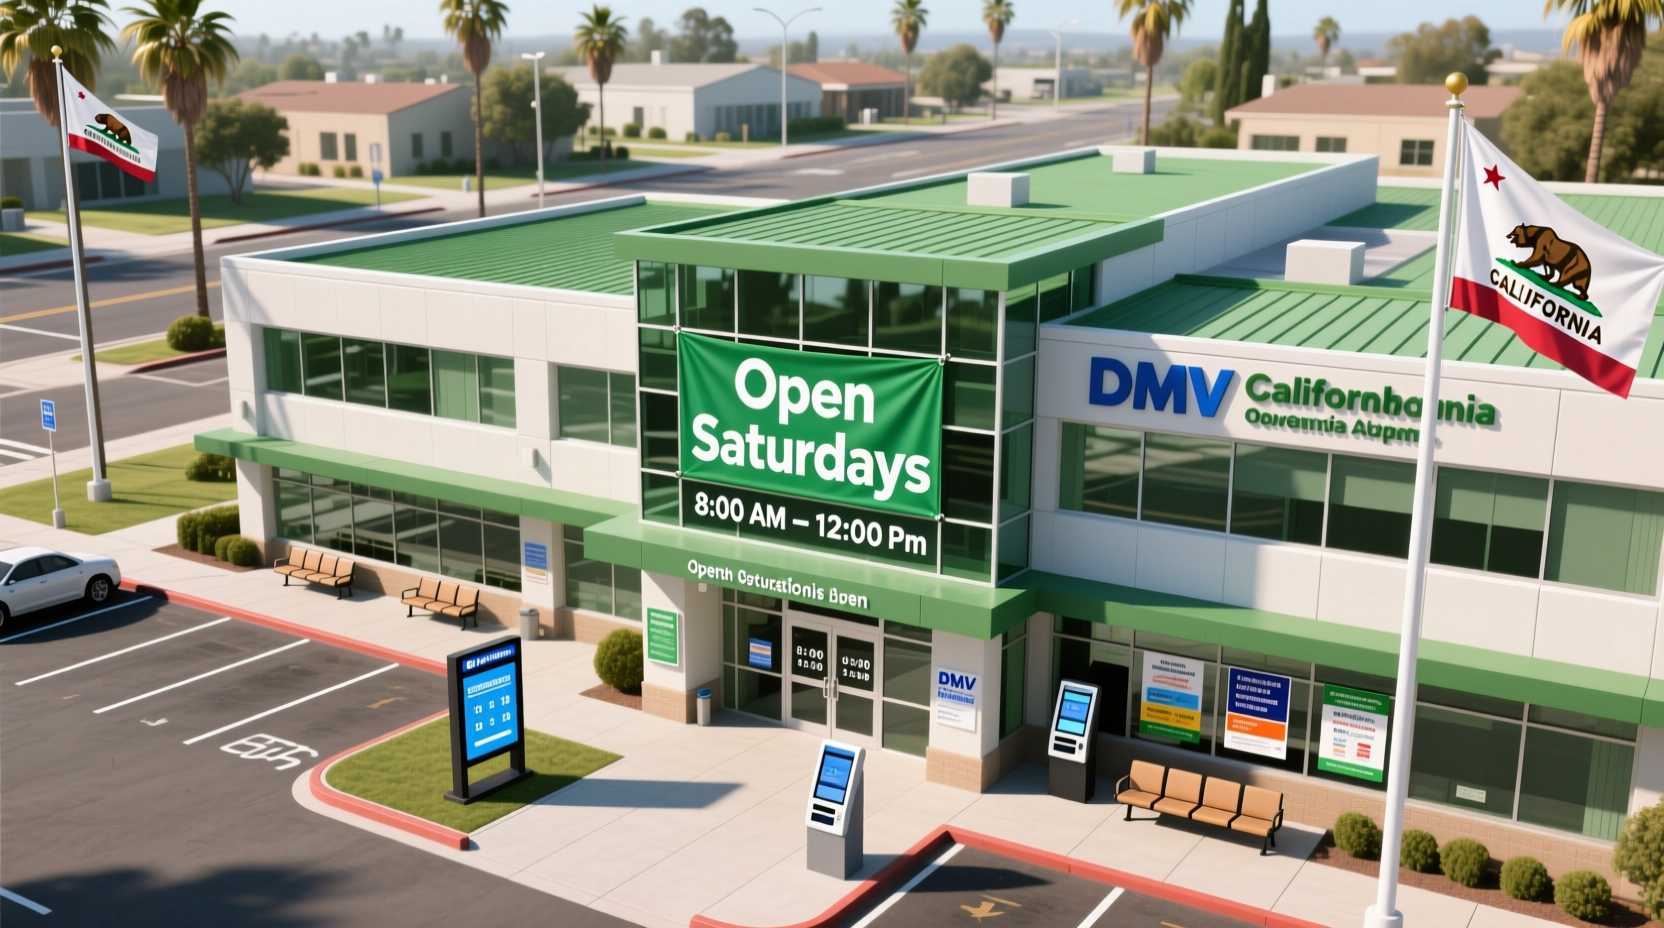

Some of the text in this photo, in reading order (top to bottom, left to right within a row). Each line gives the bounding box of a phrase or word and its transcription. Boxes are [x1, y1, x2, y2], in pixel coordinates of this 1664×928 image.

[735, 357, 875, 425] Open
[1089, 356, 1235, 418] DMV
[691, 413, 931, 501] Saturdays
[694, 491, 744, 523] 8:00
[749, 502, 786, 530] AM
[815, 513, 882, 547] 12:00
[888, 525, 927, 556] Pm
[938, 671, 977, 691] DMV
